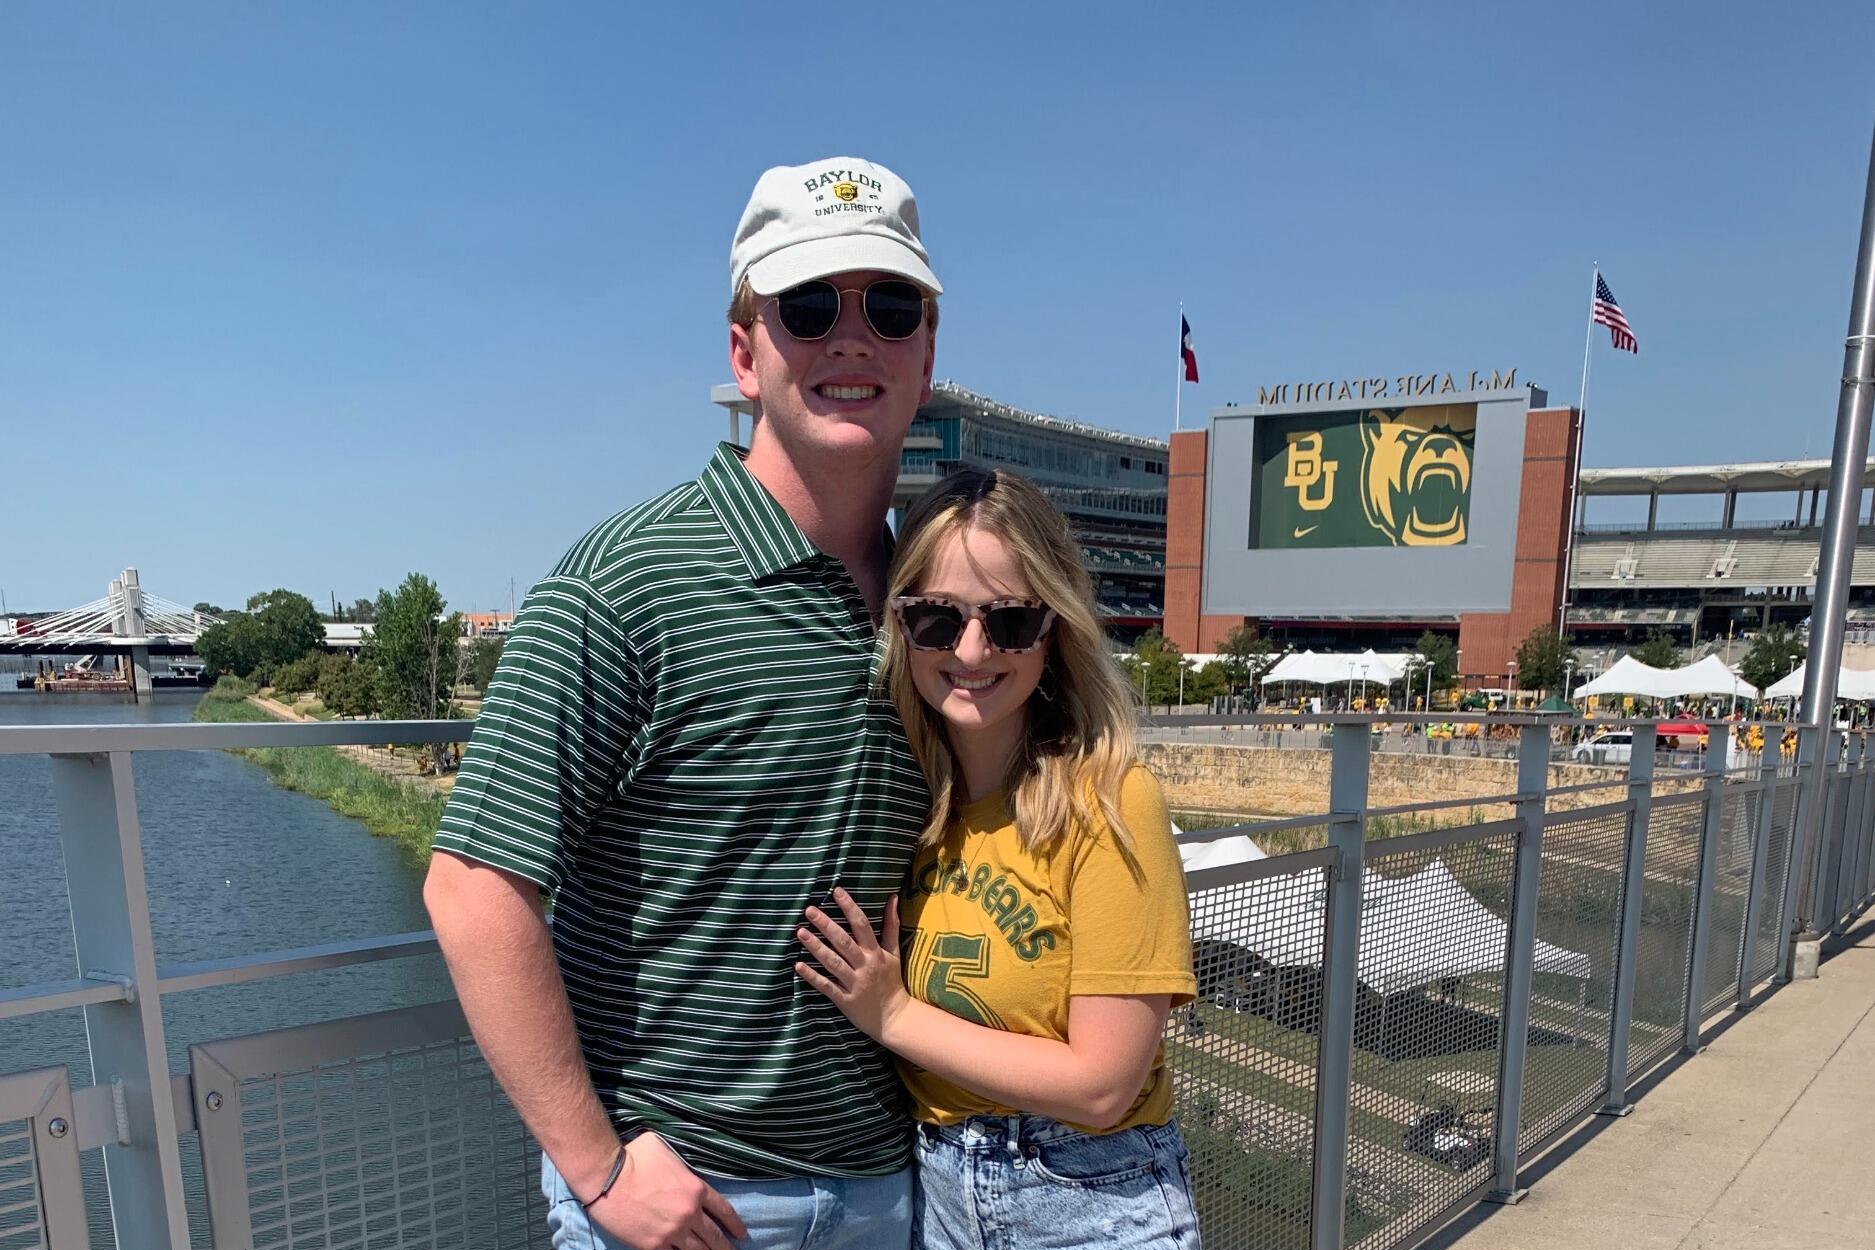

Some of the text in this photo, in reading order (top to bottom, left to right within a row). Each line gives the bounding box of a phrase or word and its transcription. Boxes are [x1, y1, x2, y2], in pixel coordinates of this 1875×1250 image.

[804, 169, 882, 192] BAYLOR
[814, 203, 883, 217] UNIVERSITY
[1284, 430, 1338, 511] BU
[965, 862, 1057, 963] BEARS
